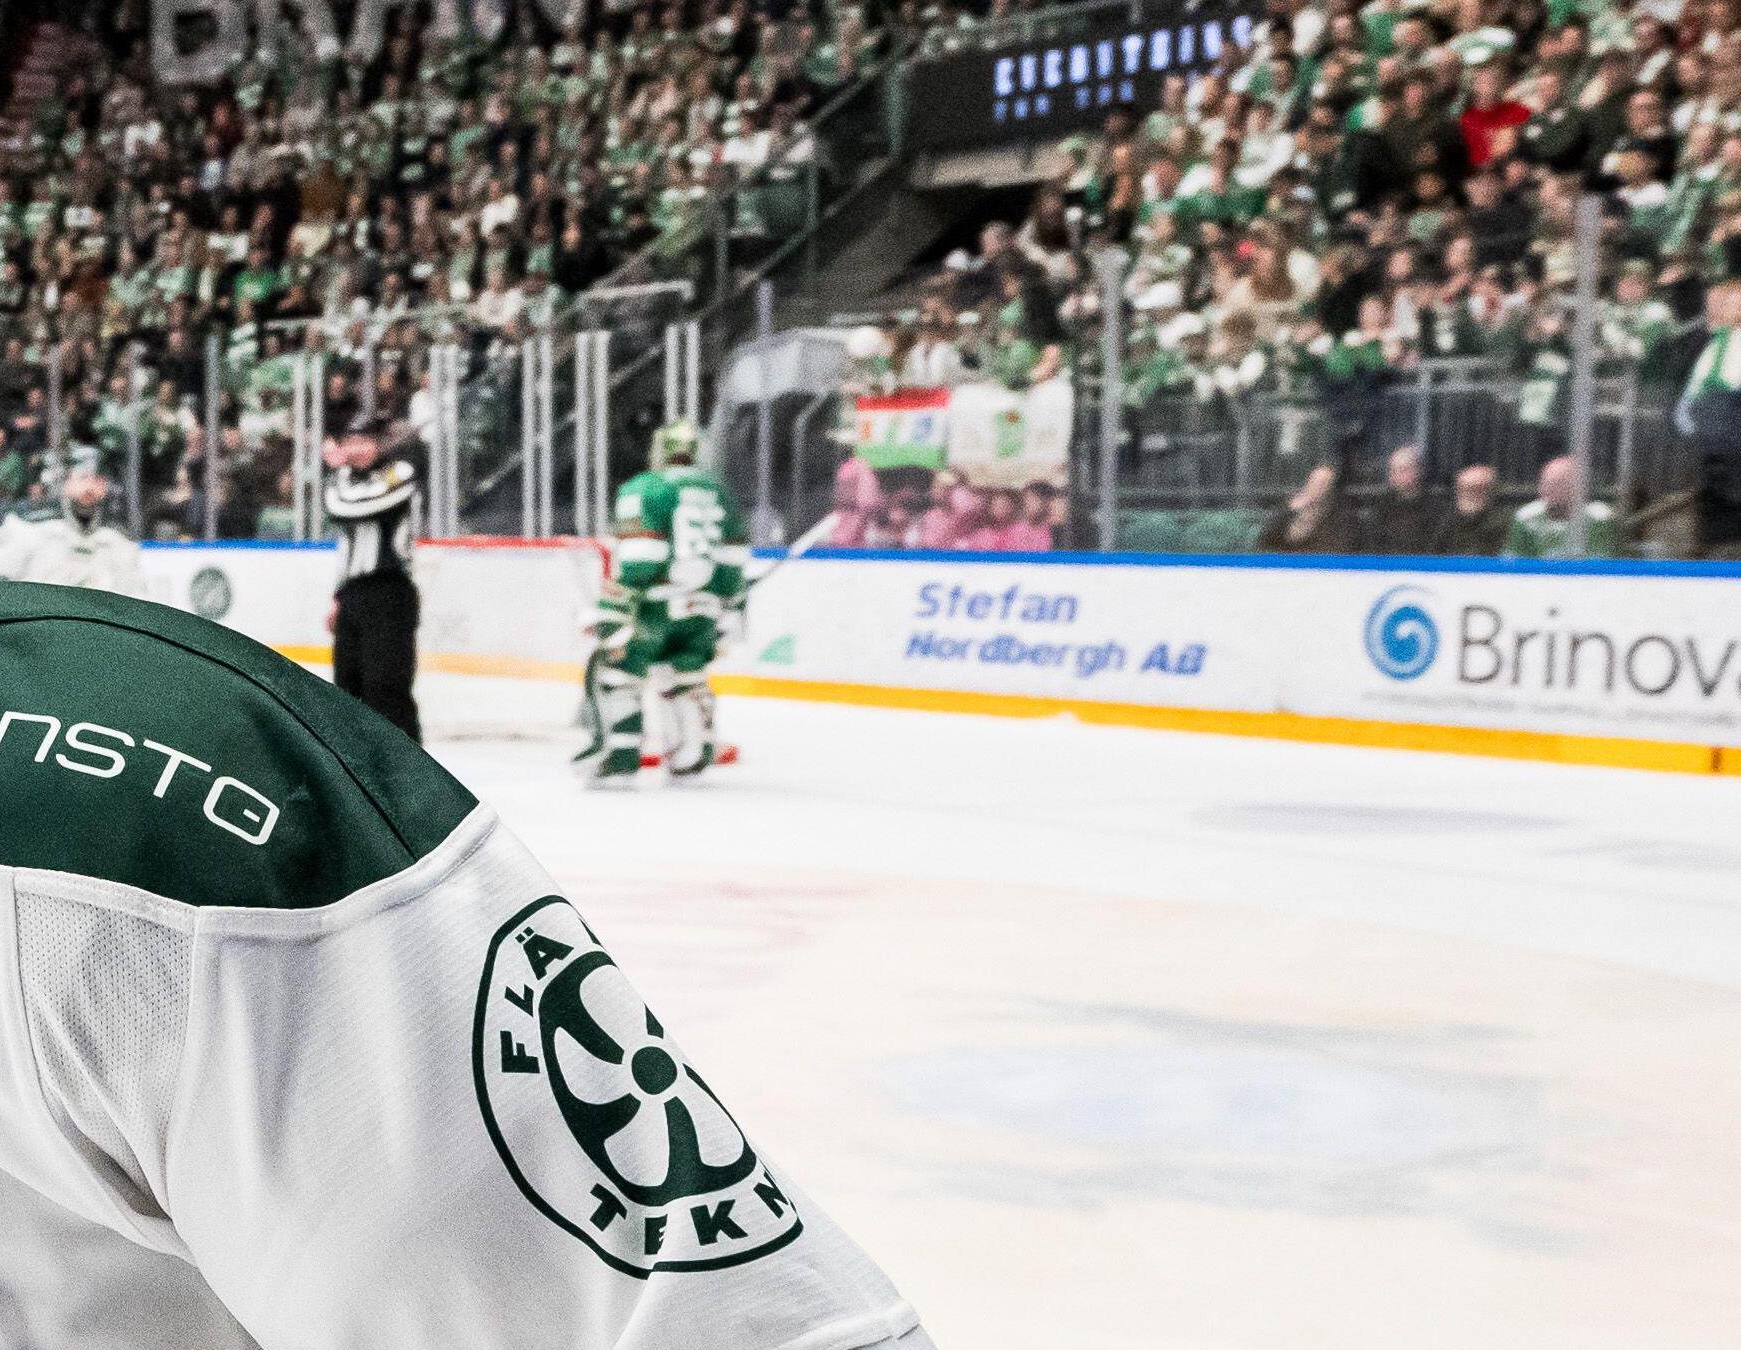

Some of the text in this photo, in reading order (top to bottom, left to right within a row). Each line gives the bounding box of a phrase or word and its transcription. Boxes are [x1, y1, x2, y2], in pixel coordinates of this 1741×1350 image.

[915, 583, 1078, 624] Stefan
[904, 628, 1207, 680] Nordbergh AB
[1456, 604, 1741, 698] Brinov
[500, 922, 592, 1073] FLÄ
[590, 1170, 788, 1255] TEKN
